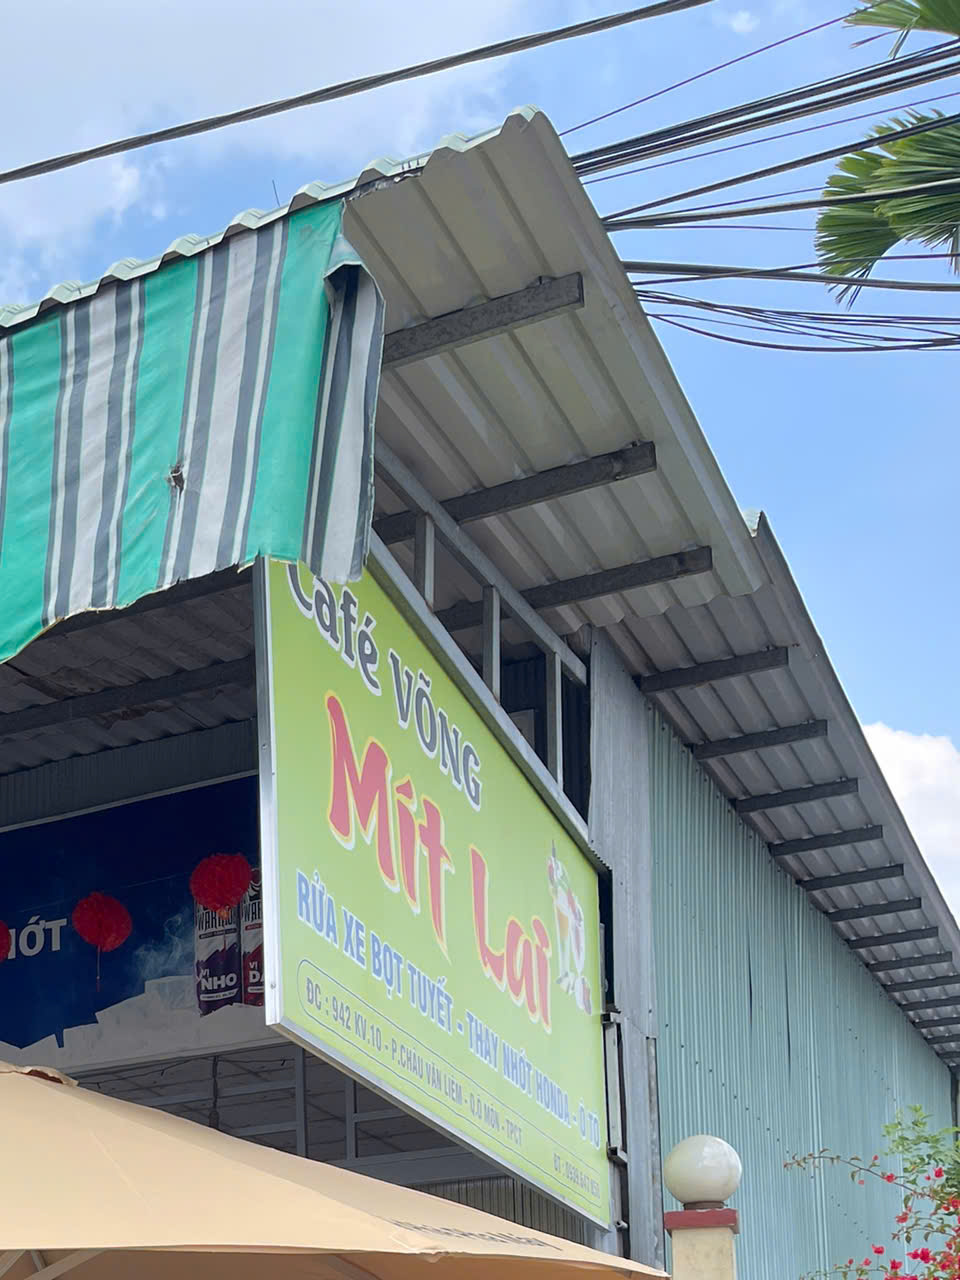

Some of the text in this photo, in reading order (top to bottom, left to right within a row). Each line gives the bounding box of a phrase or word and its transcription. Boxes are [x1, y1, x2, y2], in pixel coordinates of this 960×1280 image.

[389, 648, 481, 811] VÕNG
[324, 691, 552, 1032] Mít Lai
[200, 972, 238, 991] NHO
[296, 868, 339, 948] RỬA
[341, 905, 368, 970] XE
[370, 931, 404, 999] BỌT
[407, 960, 453, 1035] TUYẾT
[465, 1009, 499, 1072] THAY
[535, 1067, 571, 1128] HONDA
[332, 996, 351, 1032] 942
